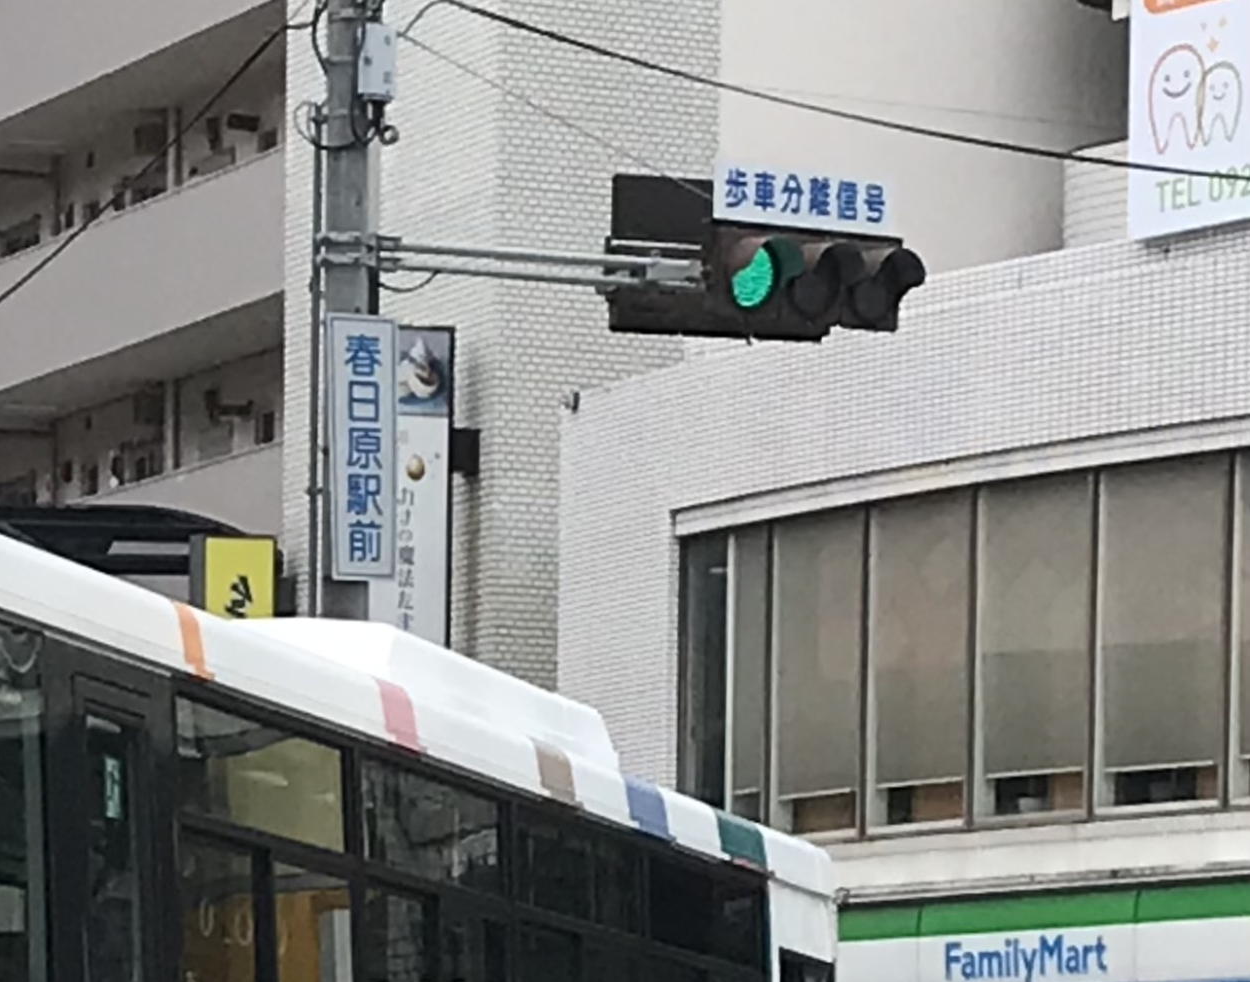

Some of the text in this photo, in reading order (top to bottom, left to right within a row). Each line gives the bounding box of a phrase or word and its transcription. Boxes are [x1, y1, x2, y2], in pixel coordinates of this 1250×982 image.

[724, 167, 886, 224] 歩車分離信号
[1154, 177, 1201, 213] TEL
[343, 333, 383, 564] 春日原駅前
